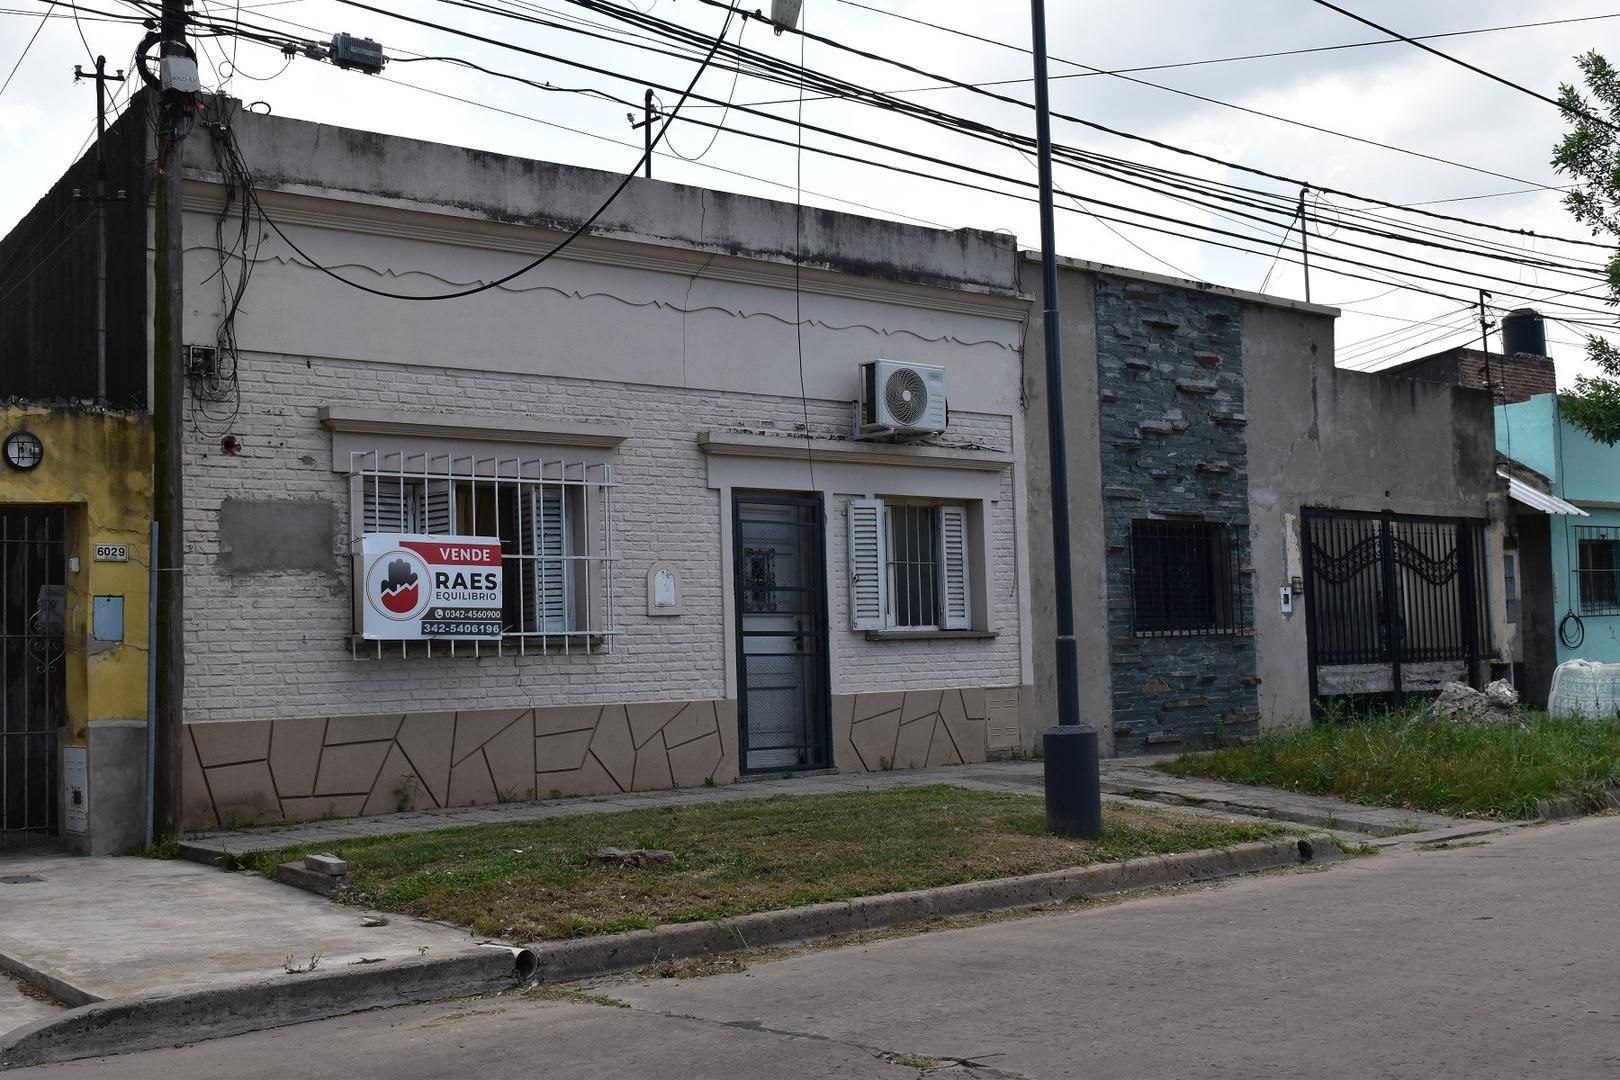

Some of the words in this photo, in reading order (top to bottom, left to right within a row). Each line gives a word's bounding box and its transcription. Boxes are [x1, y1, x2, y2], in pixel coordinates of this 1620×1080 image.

[97, 547, 125, 557] 6029
[439, 547, 491, 562] VENDE
[435, 571, 498, 591] RAES
[436, 591, 497, 602] EQUILIBRIO
[445, 609, 501, 619] 0342-4560900
[423, 623, 500, 634] 342-5406196
